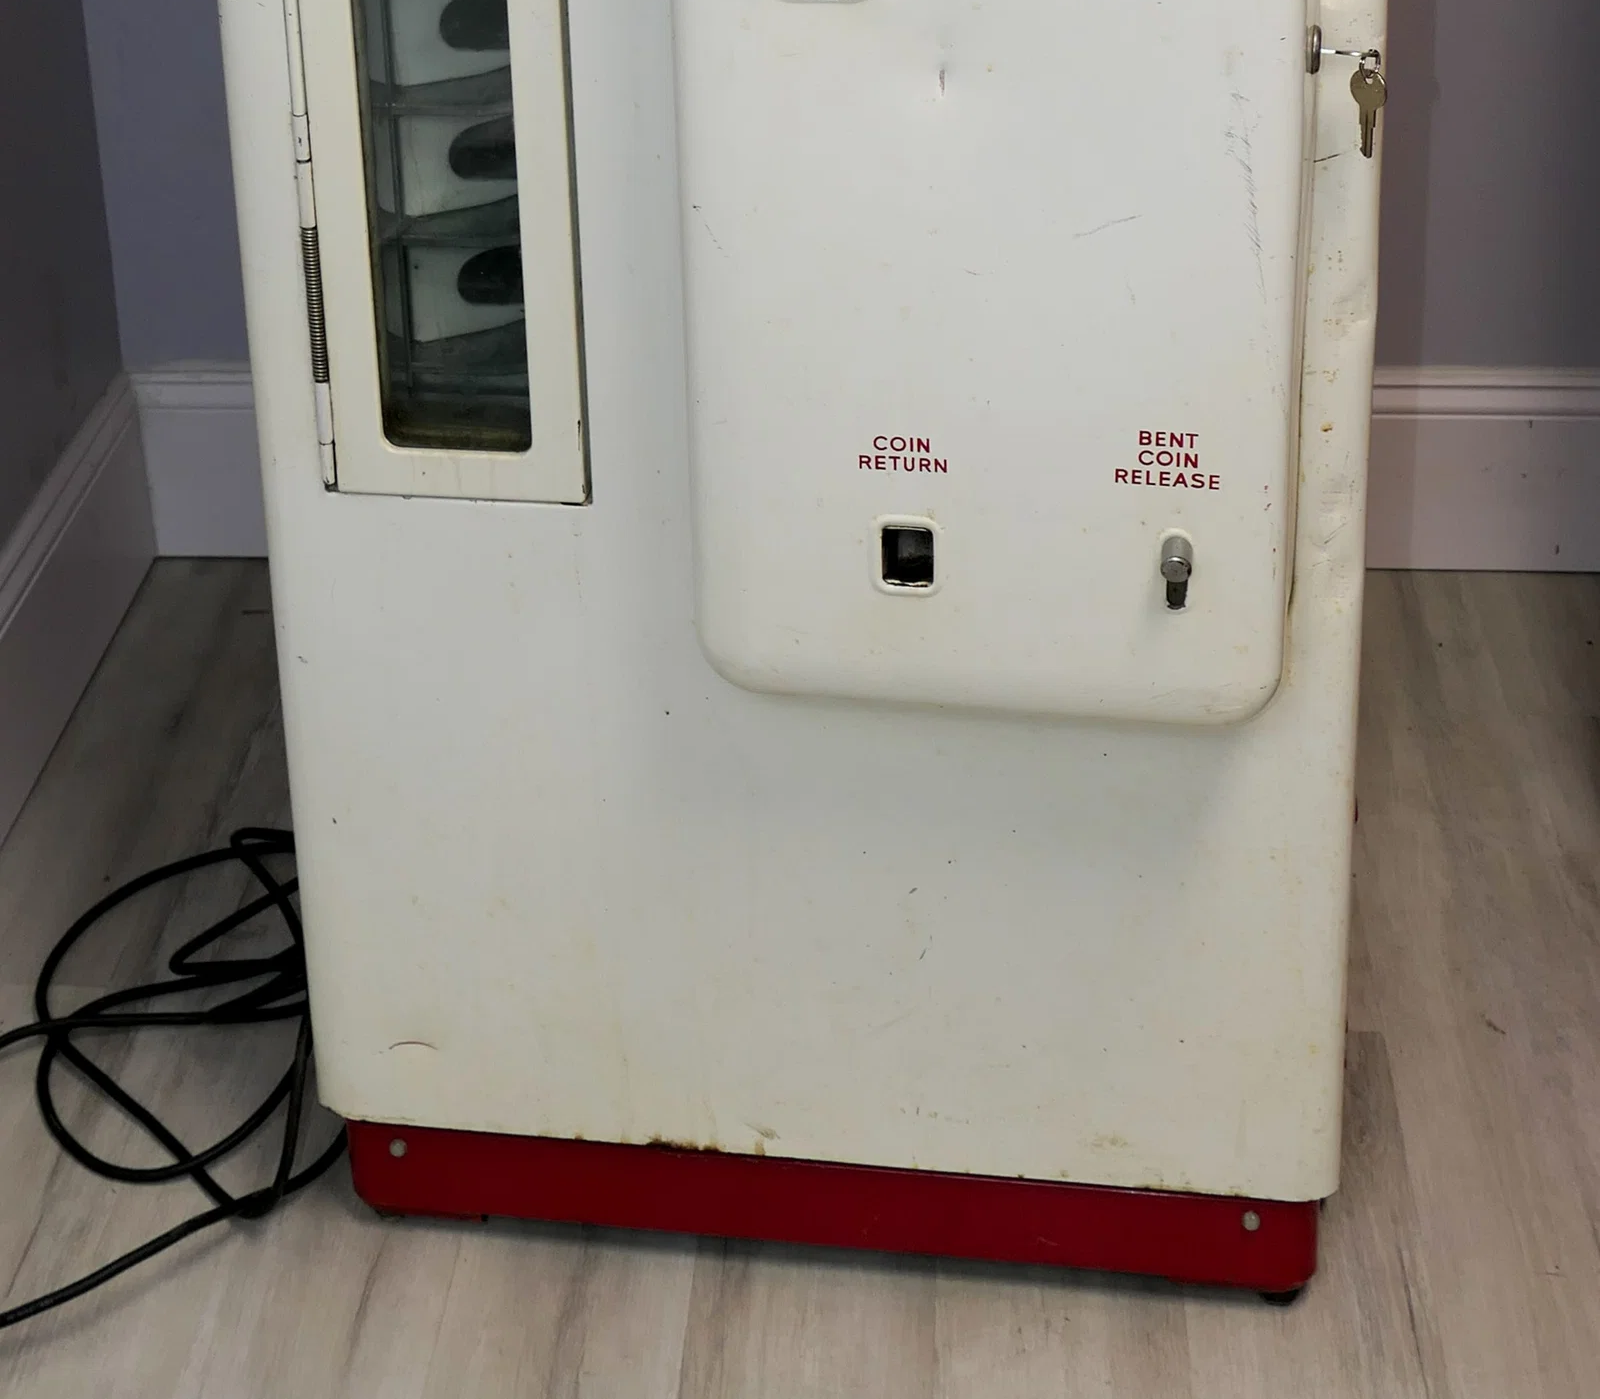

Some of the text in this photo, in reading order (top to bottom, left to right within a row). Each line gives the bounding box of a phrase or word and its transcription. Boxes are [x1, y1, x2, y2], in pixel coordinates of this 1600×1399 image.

[873, 435, 931, 454] COIN
[1138, 430, 1199, 449] BENT
[858, 454, 948, 474] RETURN
[1137, 449, 1199, 469] COIN
[1114, 468, 1221, 490] RELEASE
